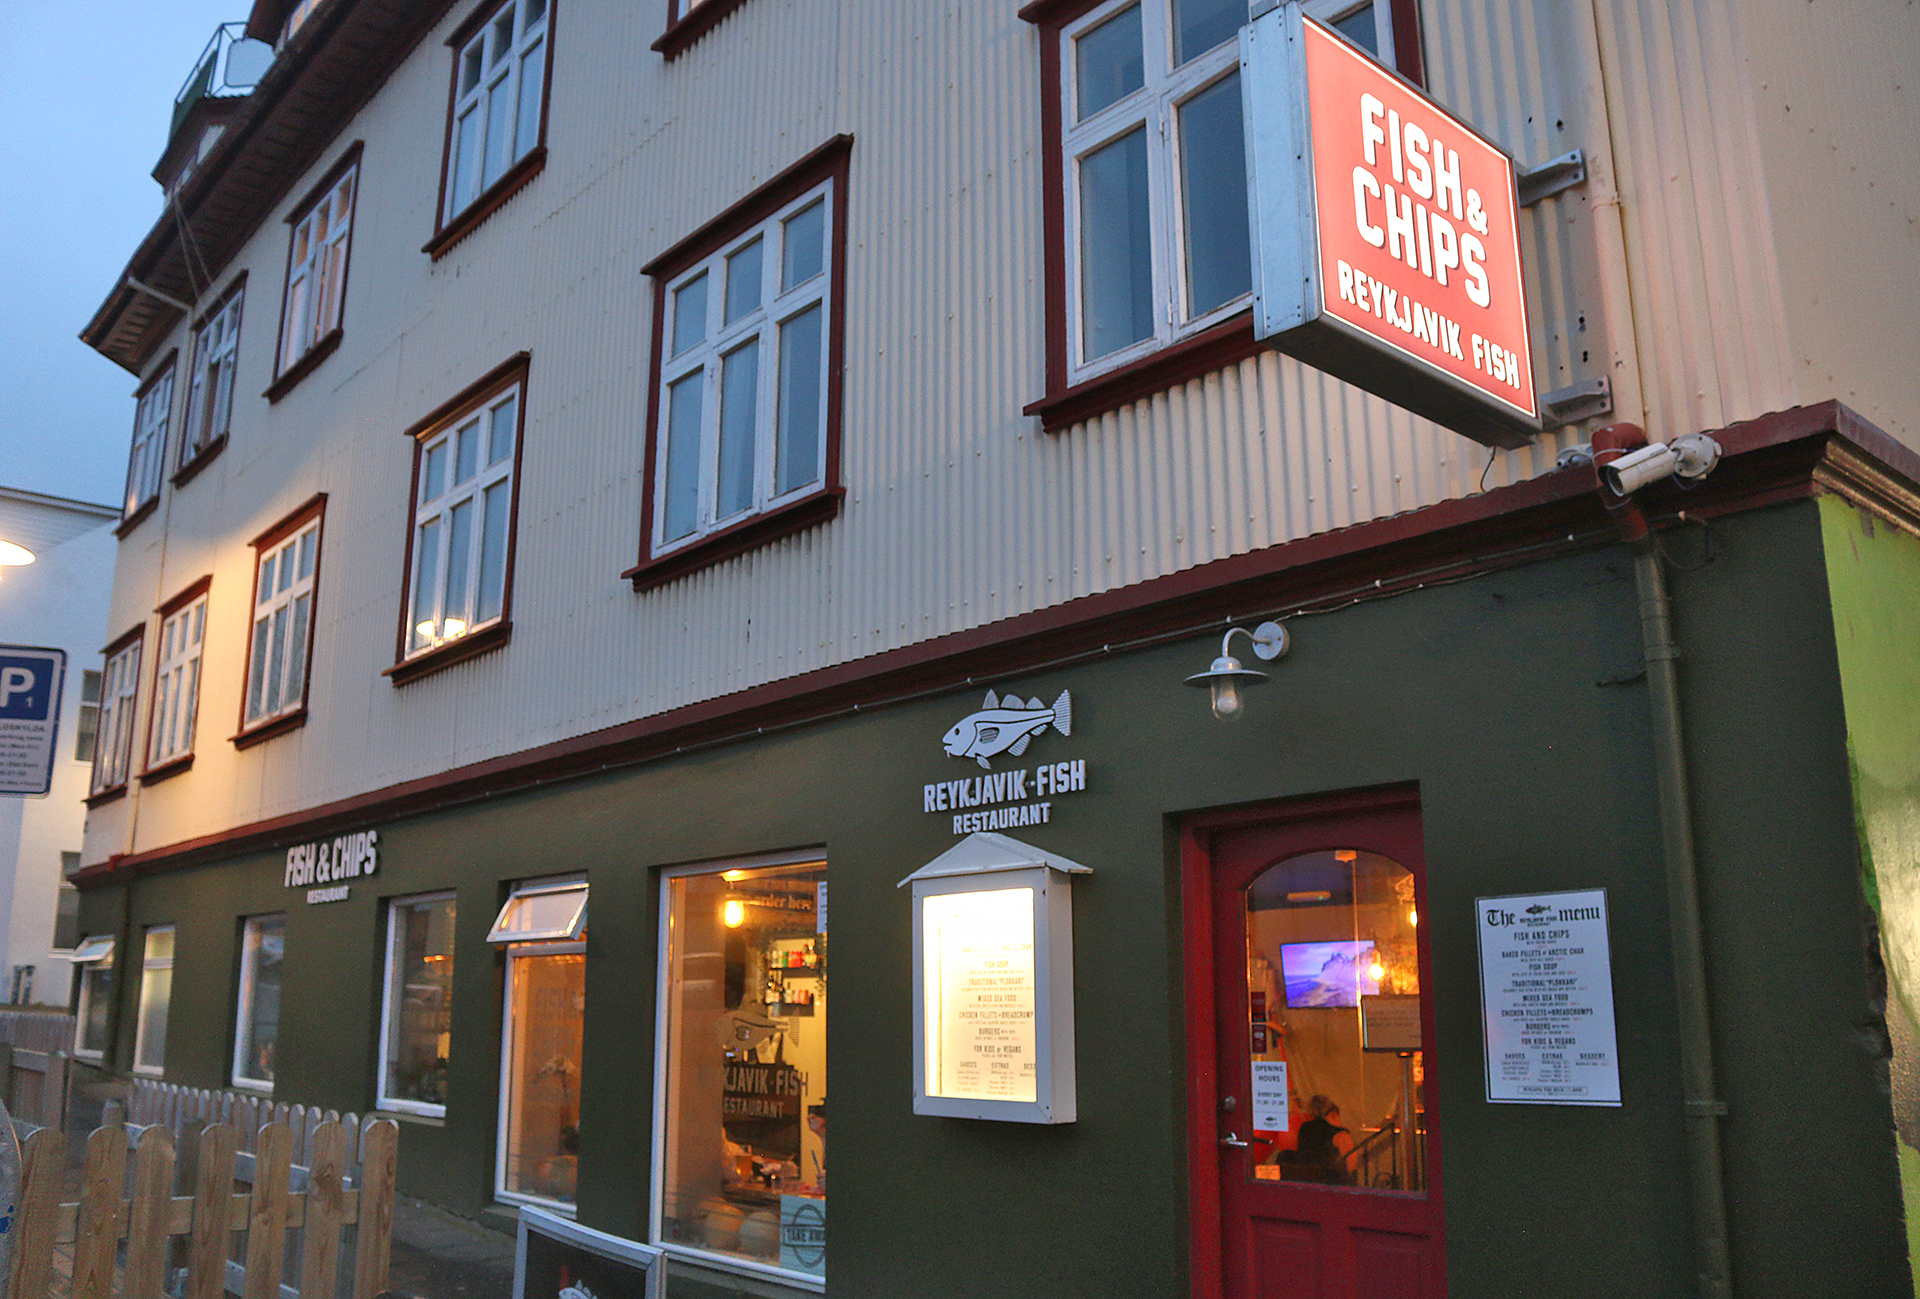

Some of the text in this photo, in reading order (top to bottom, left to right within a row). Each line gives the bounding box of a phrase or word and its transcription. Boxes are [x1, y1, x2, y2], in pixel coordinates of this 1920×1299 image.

[1360, 92, 1488, 235] FISH &
[1352, 165, 1490, 309] CHIPS
[1337, 259, 1521, 390] REYKJAVIK FISH
[0, 666, 35, 708] P
[924, 759, 1086, 813] REYKJAVIK FISH
[953, 802, 1051, 835] RESTAURANT
[284, 829, 377, 888] FISH & CHIPS
[1486, 907, 1600, 928] The menu
[1514, 929, 1570, 941] FISH AND CHIPS
[1521, 949, 1541, 958] FILLETS
[1548, 948, 1568, 956] ARCTIC
[1569, 947, 1584, 955] CHAR
[1529, 962, 1558, 971] FISH SOUP
[1511, 980, 1546, 988] TRADITIONAL
[994, 994, 1003, 1002] SEA
[1004, 994, 1017, 1002] FOOD
[1522, 994, 1540, 1002] MIXED
[1554, 993, 1569, 1001] FOOD
[959, 1011, 978, 1019] CHICKEN
[980, 1011, 997, 1019] FILLETS
[1001, 1011, 1034, 1019] BREADCRUMP
[1501, 1009, 1524, 1017] CHICKEN
[1526, 1008, 1547, 1016] FILLETS
[979, 1027, 1000, 1035] BURGERS
[1526, 1023, 1551, 1031] BURGERS
[1521, 1037, 1532, 1045] FOR
[1533, 1037, 1547, 1045] KIDS
[974, 1045, 982, 1053] FOR
[984, 1045, 995, 1053] KIDS
[1541, 1052, 1563, 1060] EXTRAS
[1255, 1065, 1284, 1073] OPENING
[1258, 1075, 1281, 1083] HOURS
[722, 1097, 784, 1118] ESTAURANT
